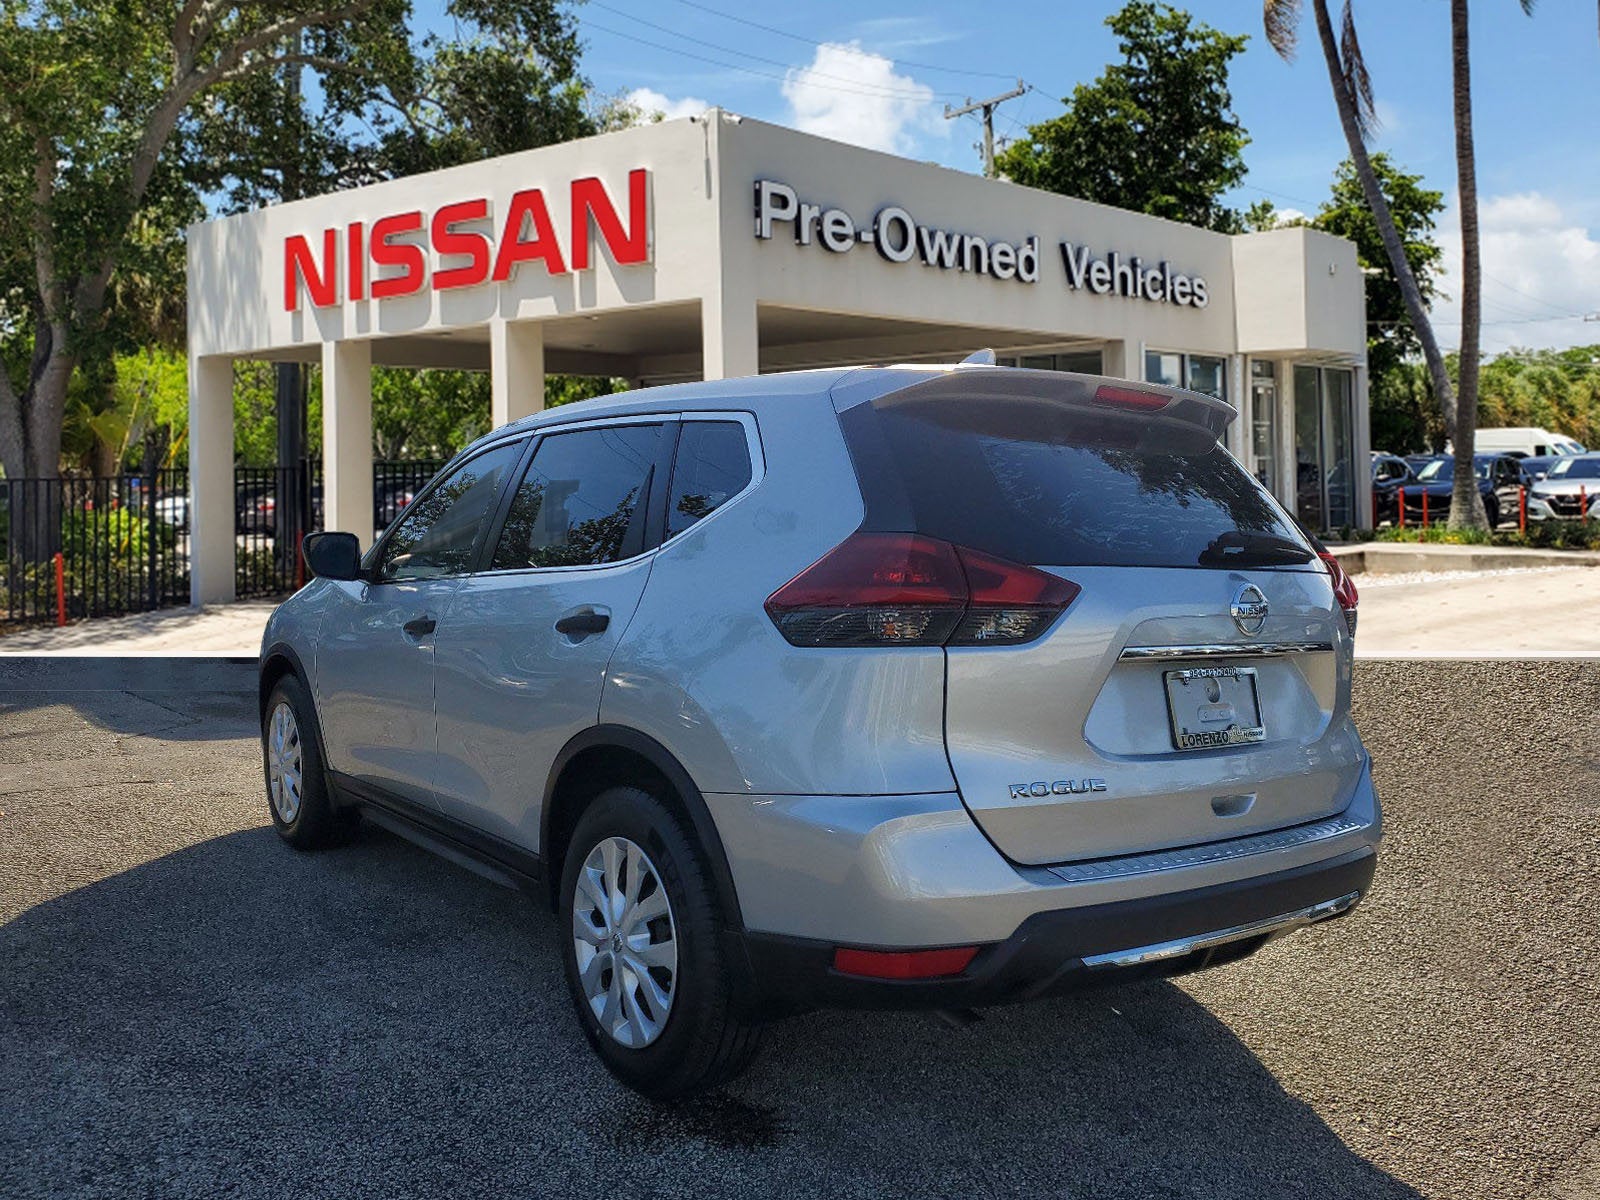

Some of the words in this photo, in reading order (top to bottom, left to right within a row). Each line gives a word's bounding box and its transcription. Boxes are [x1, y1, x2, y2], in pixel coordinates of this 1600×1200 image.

[285, 168, 648, 312] NISSAN
[754, 180, 1040, 284] Pre-Owned
[1060, 242, 1209, 309] Vehicles
[1181, 731, 1229, 748] LORENZO
[1008, 779, 1107, 799] ROGUE
